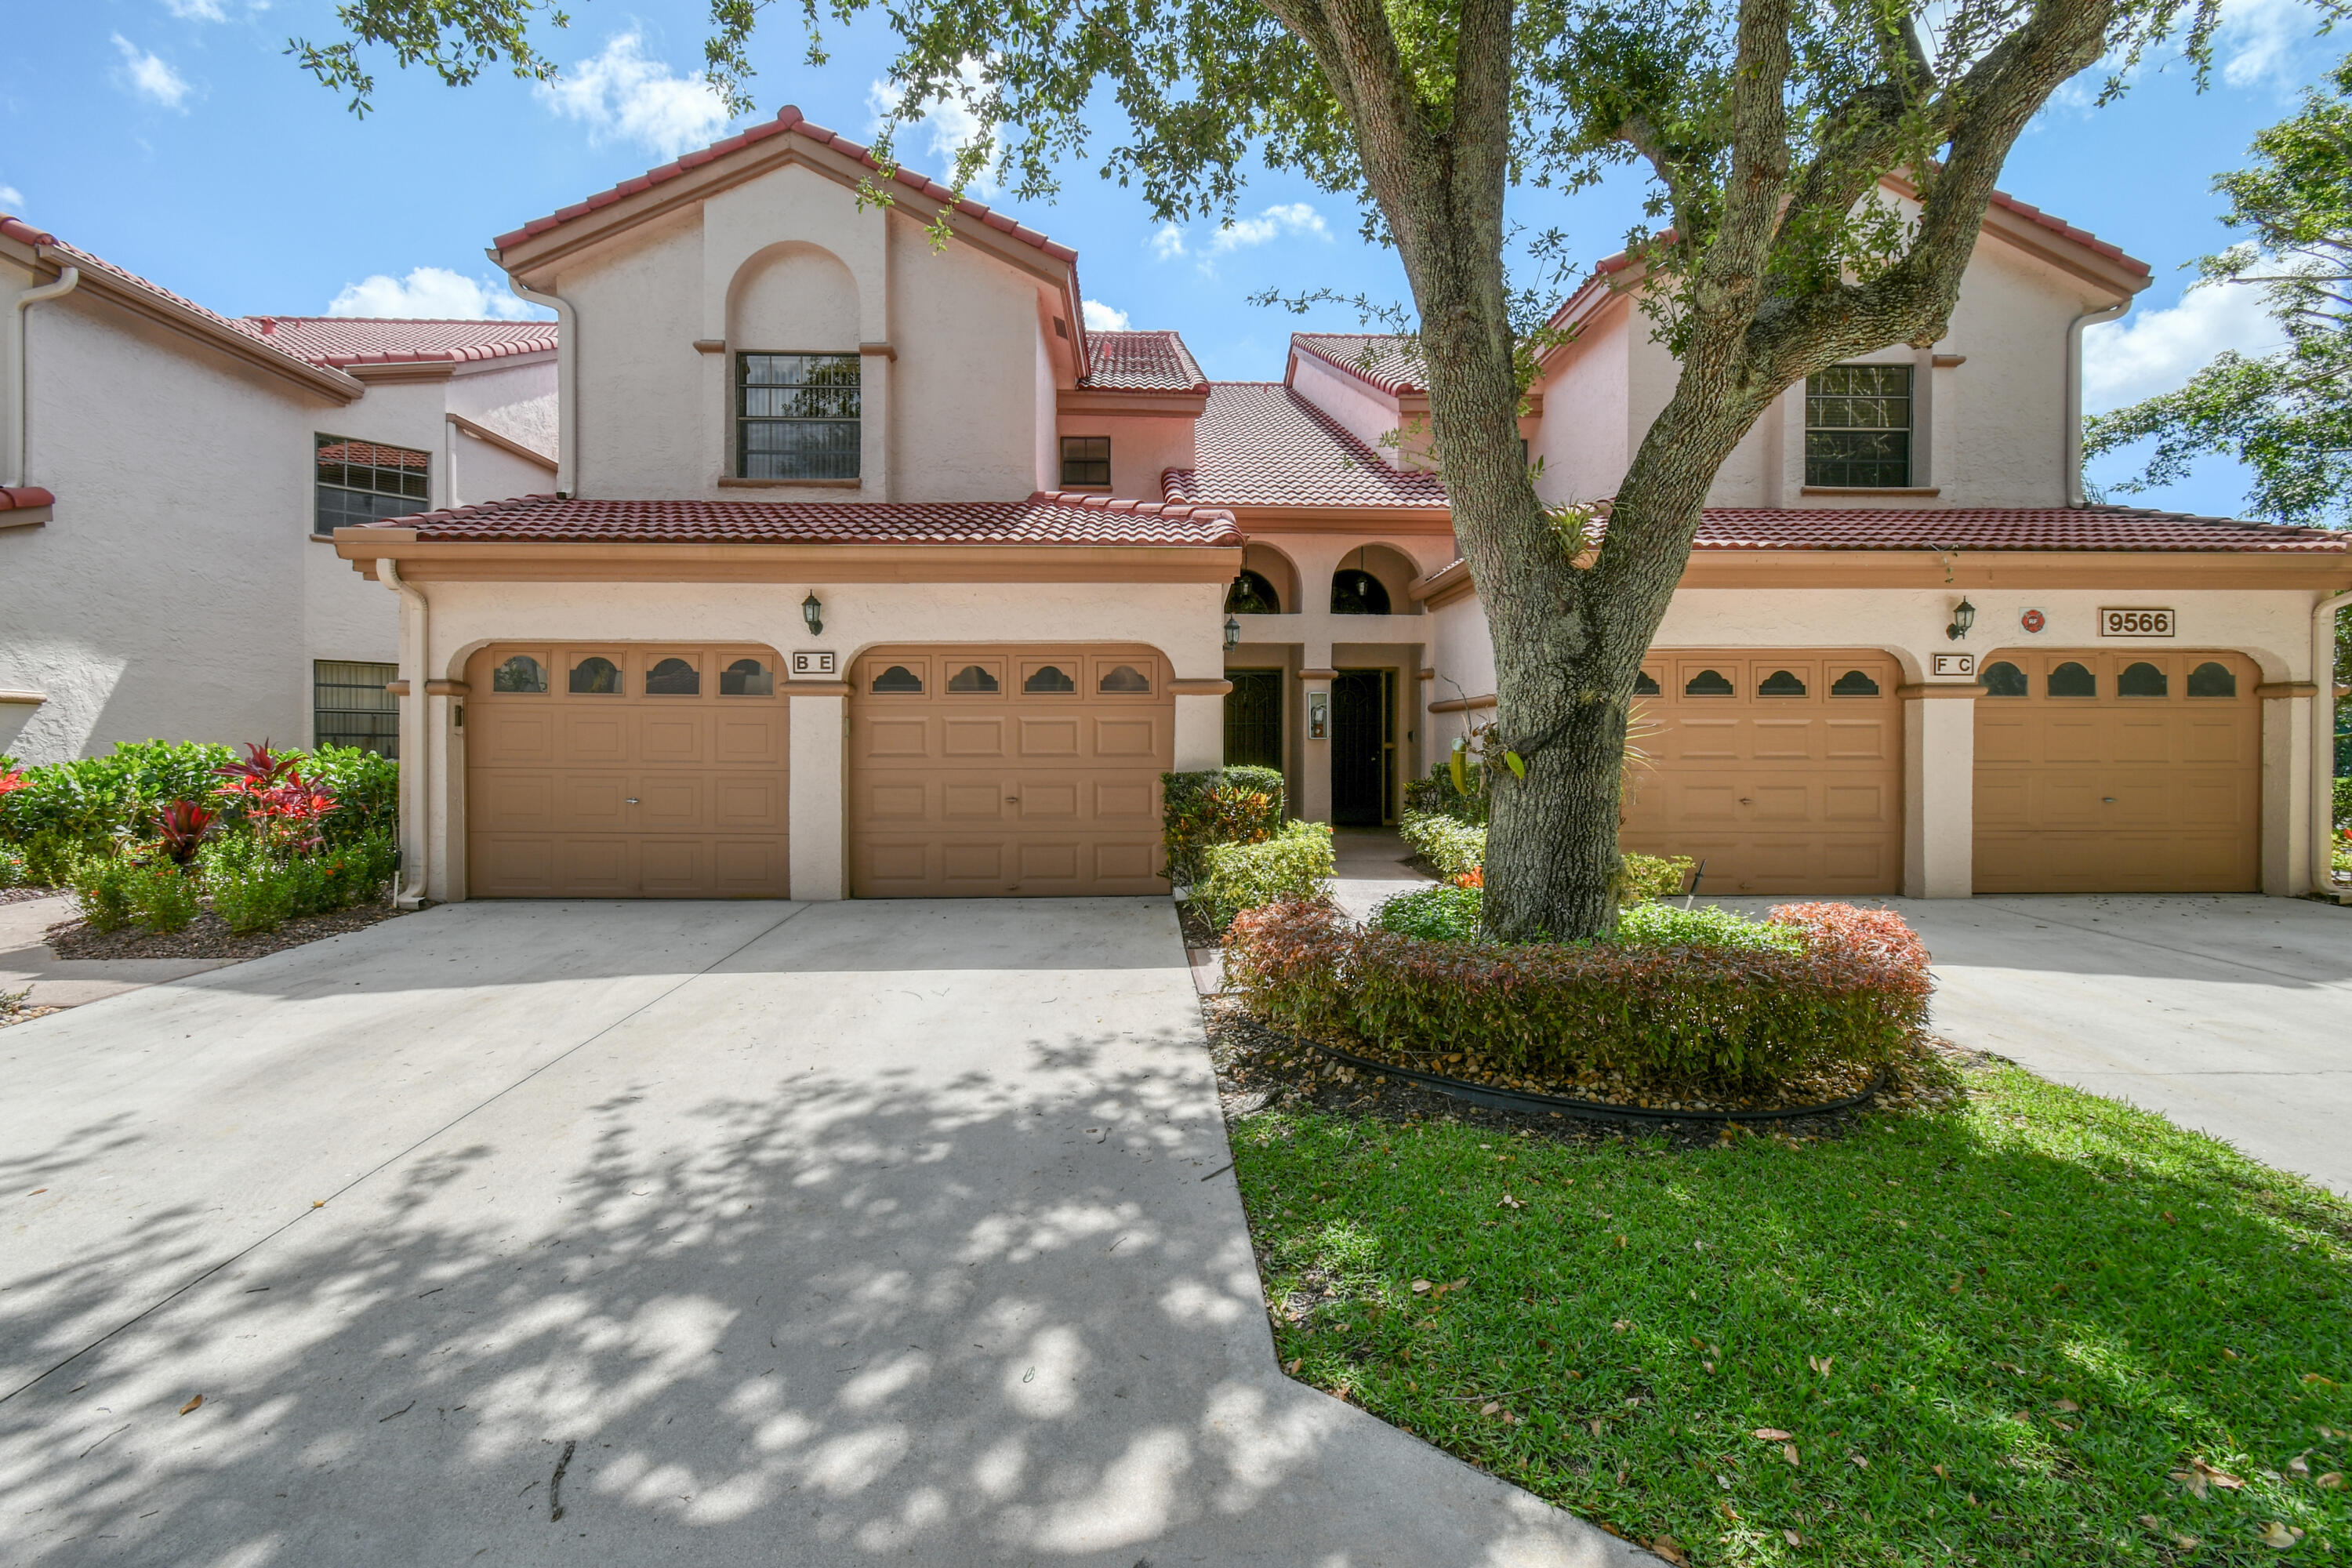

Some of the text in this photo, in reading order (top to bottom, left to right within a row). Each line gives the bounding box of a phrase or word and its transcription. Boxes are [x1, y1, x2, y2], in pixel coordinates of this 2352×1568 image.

[2109, 613, 2168, 632] 9566
[797, 655, 831, 670] B E
[1937, 658, 1970, 671] F C
